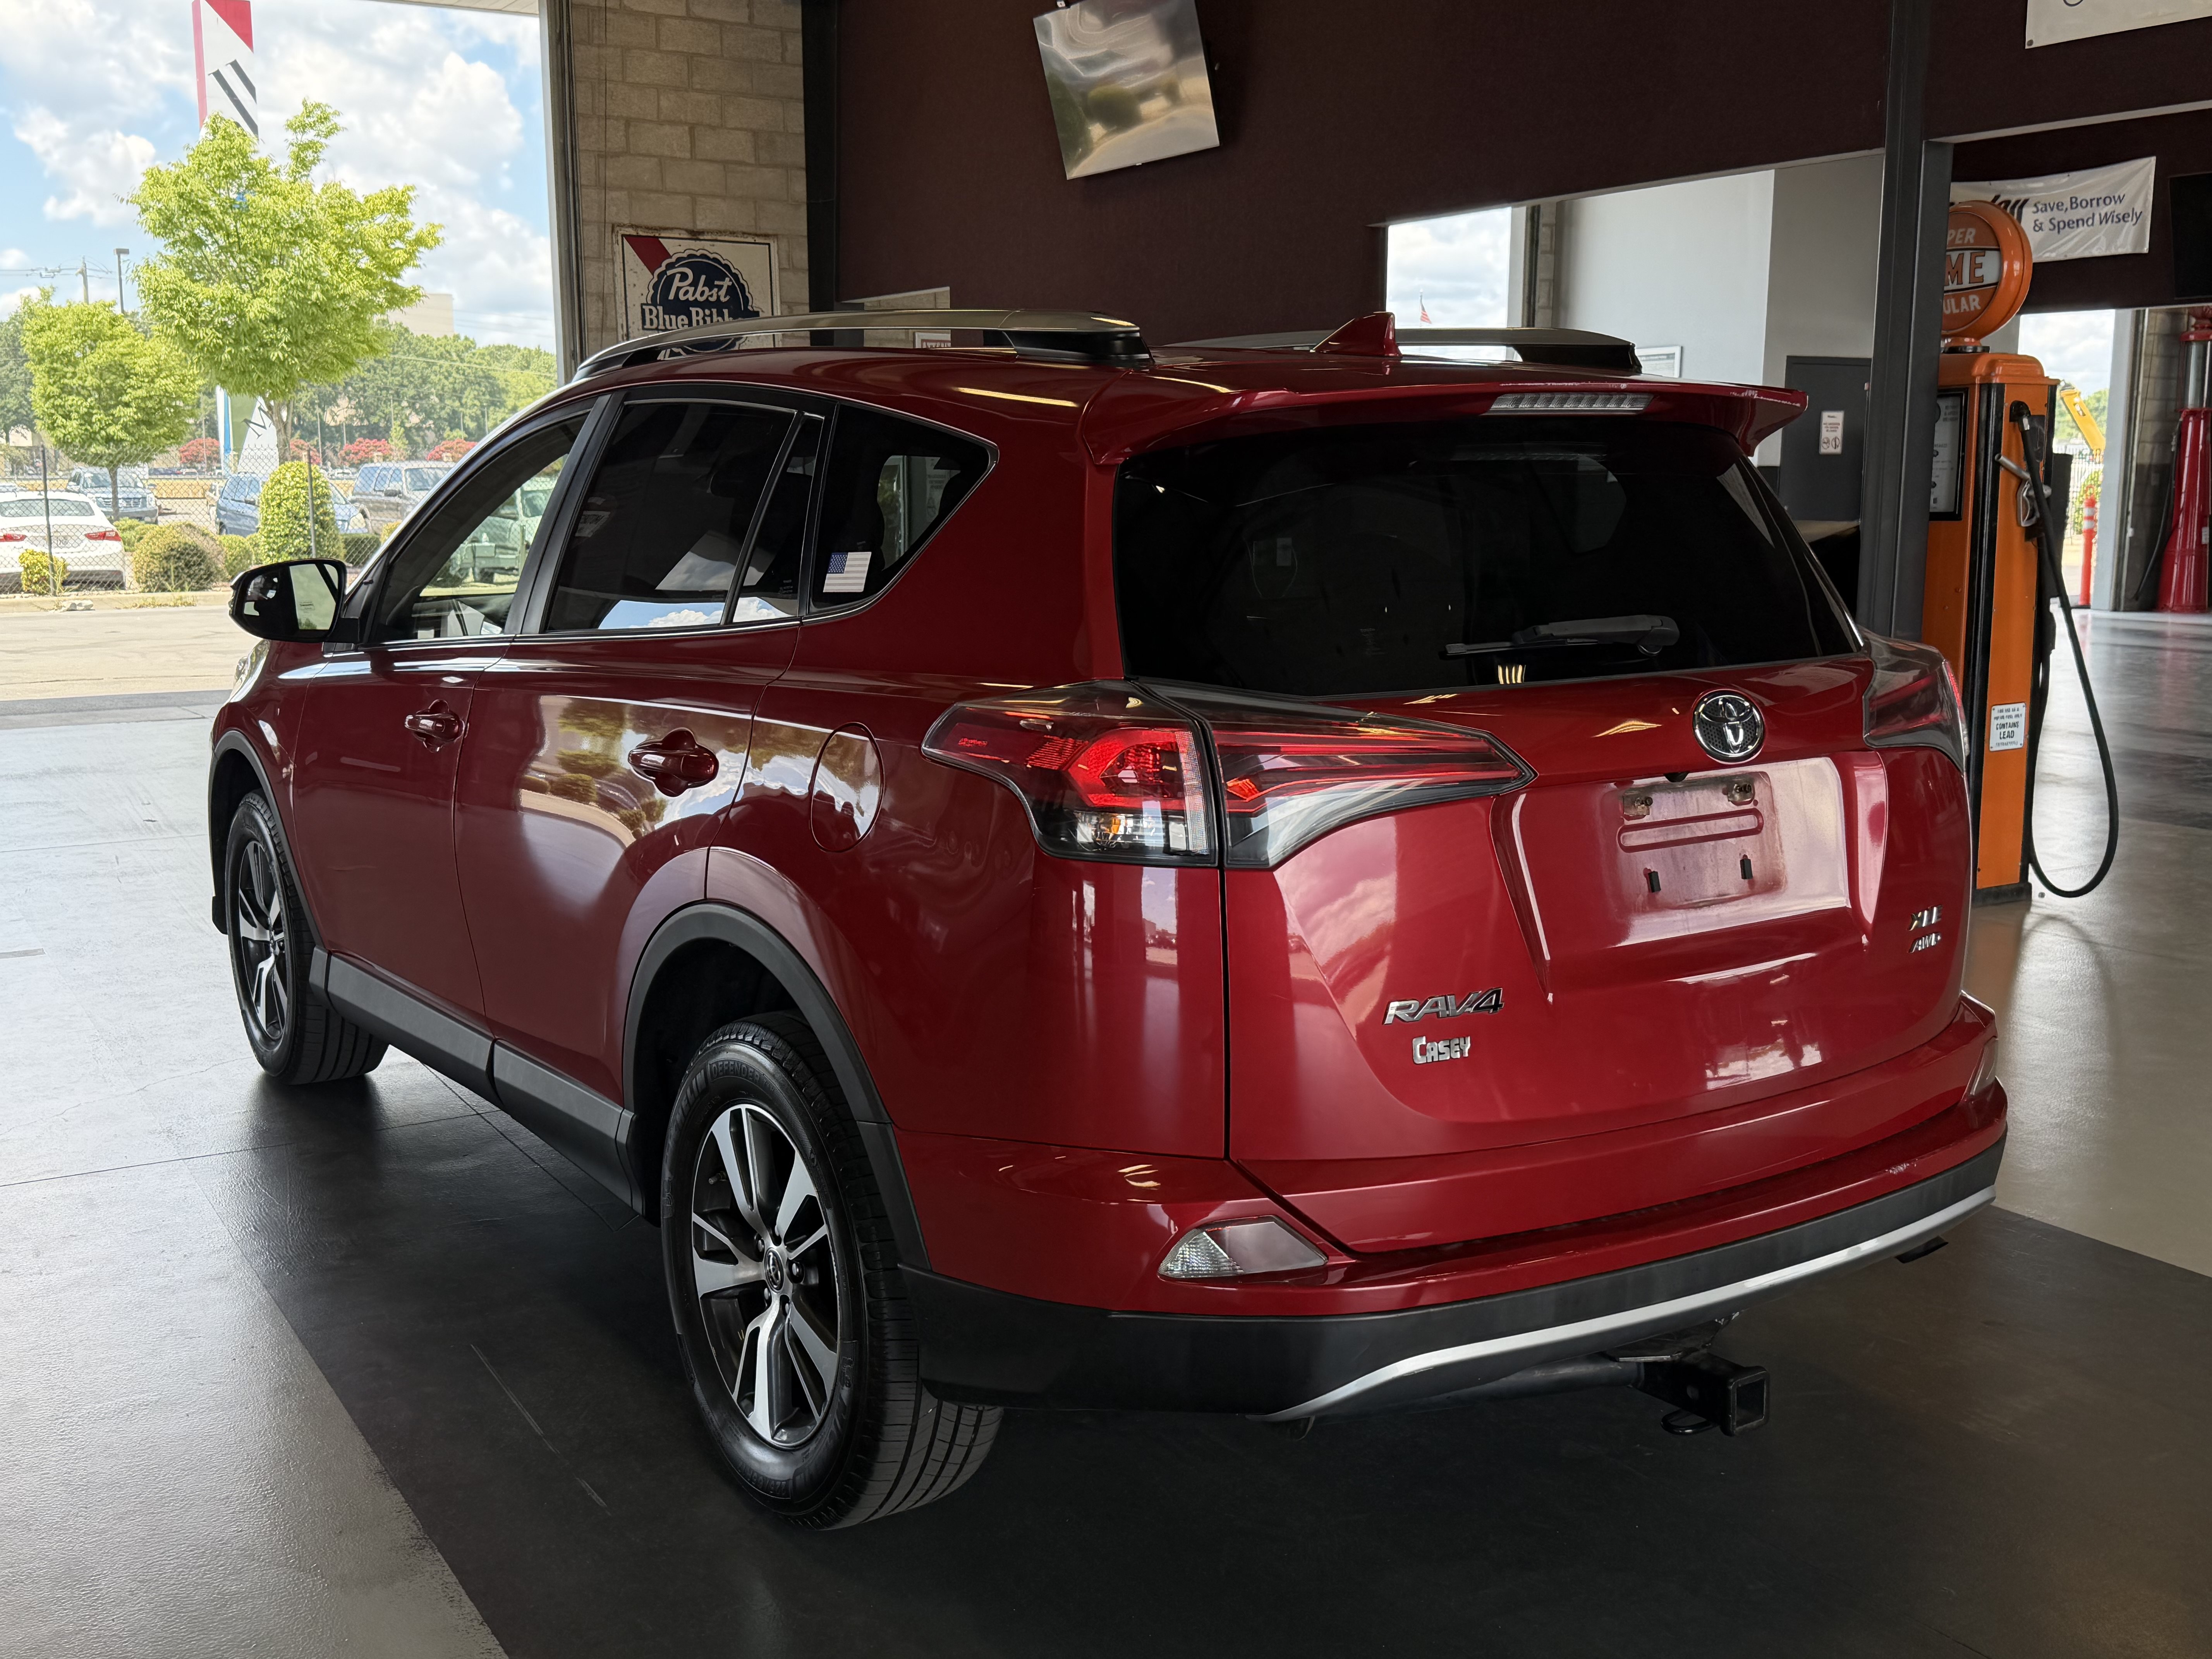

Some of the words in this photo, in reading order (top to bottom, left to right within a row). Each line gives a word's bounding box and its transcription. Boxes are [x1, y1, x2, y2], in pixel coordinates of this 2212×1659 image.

[2070, 194, 2126, 210] Borrow
[2033, 220, 2043, 232] &
[2049, 213, 2094, 234] Spend
[2098, 208, 2143, 226] Wisely
[1947, 227, 1976, 244] PER
[1944, 251, 1985, 287] ME
[666, 267, 732, 302] Pabst
[1944, 294, 1981, 314] ULAR
[642, 305, 689, 329] Blue
[689, 307, 734, 327] Ribb
[1996, 721, 2019, 730] CONTAINS
[1999, 730, 2014, 740] LEAD
[1908, 905, 1942, 931] XLE
[1908, 933, 1941, 953] AWD
[1382, 987, 1505, 1025] RAV4
[712, 1061, 760, 1083] DEFENDER
